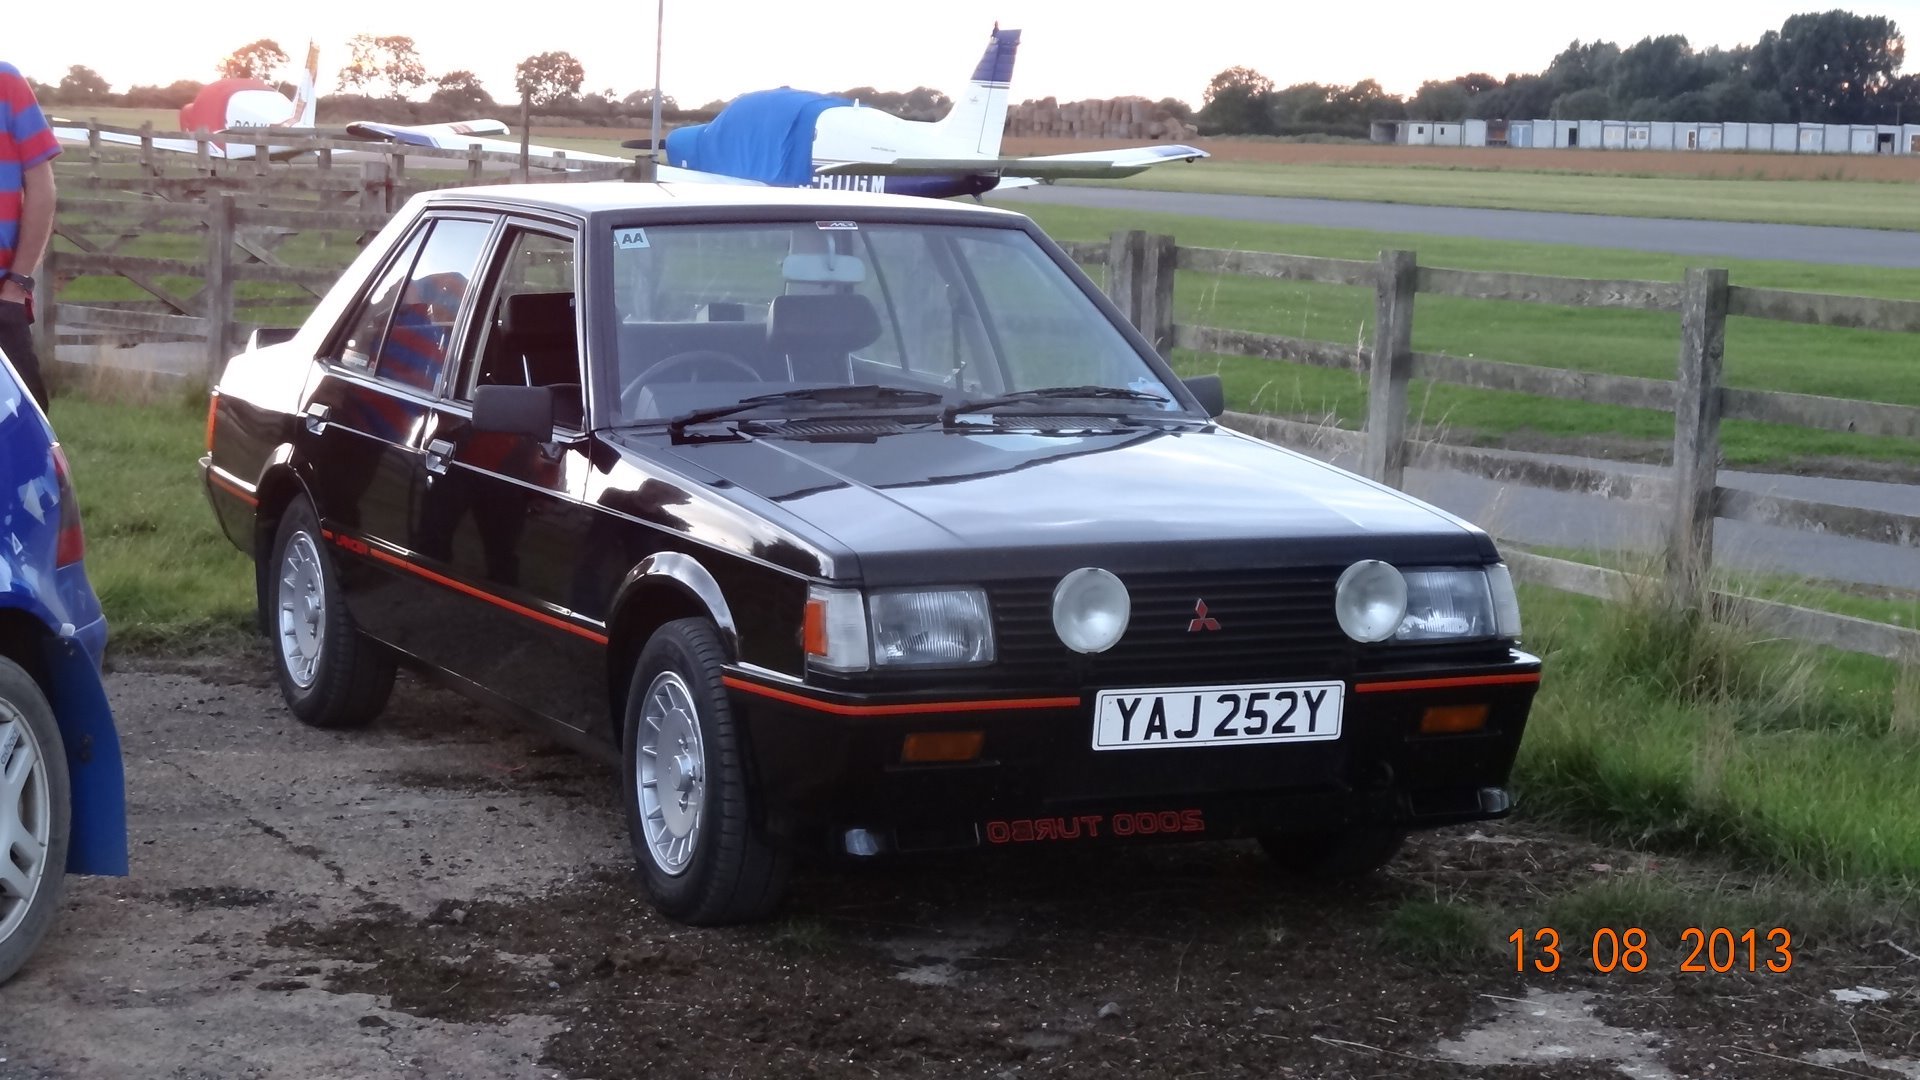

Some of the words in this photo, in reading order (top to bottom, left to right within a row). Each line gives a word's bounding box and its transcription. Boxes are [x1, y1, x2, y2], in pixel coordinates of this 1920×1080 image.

[622, 232, 643, 244] AA
[1116, 694, 1202, 741] YAJ
[1213, 689, 1328, 737] 252Y
